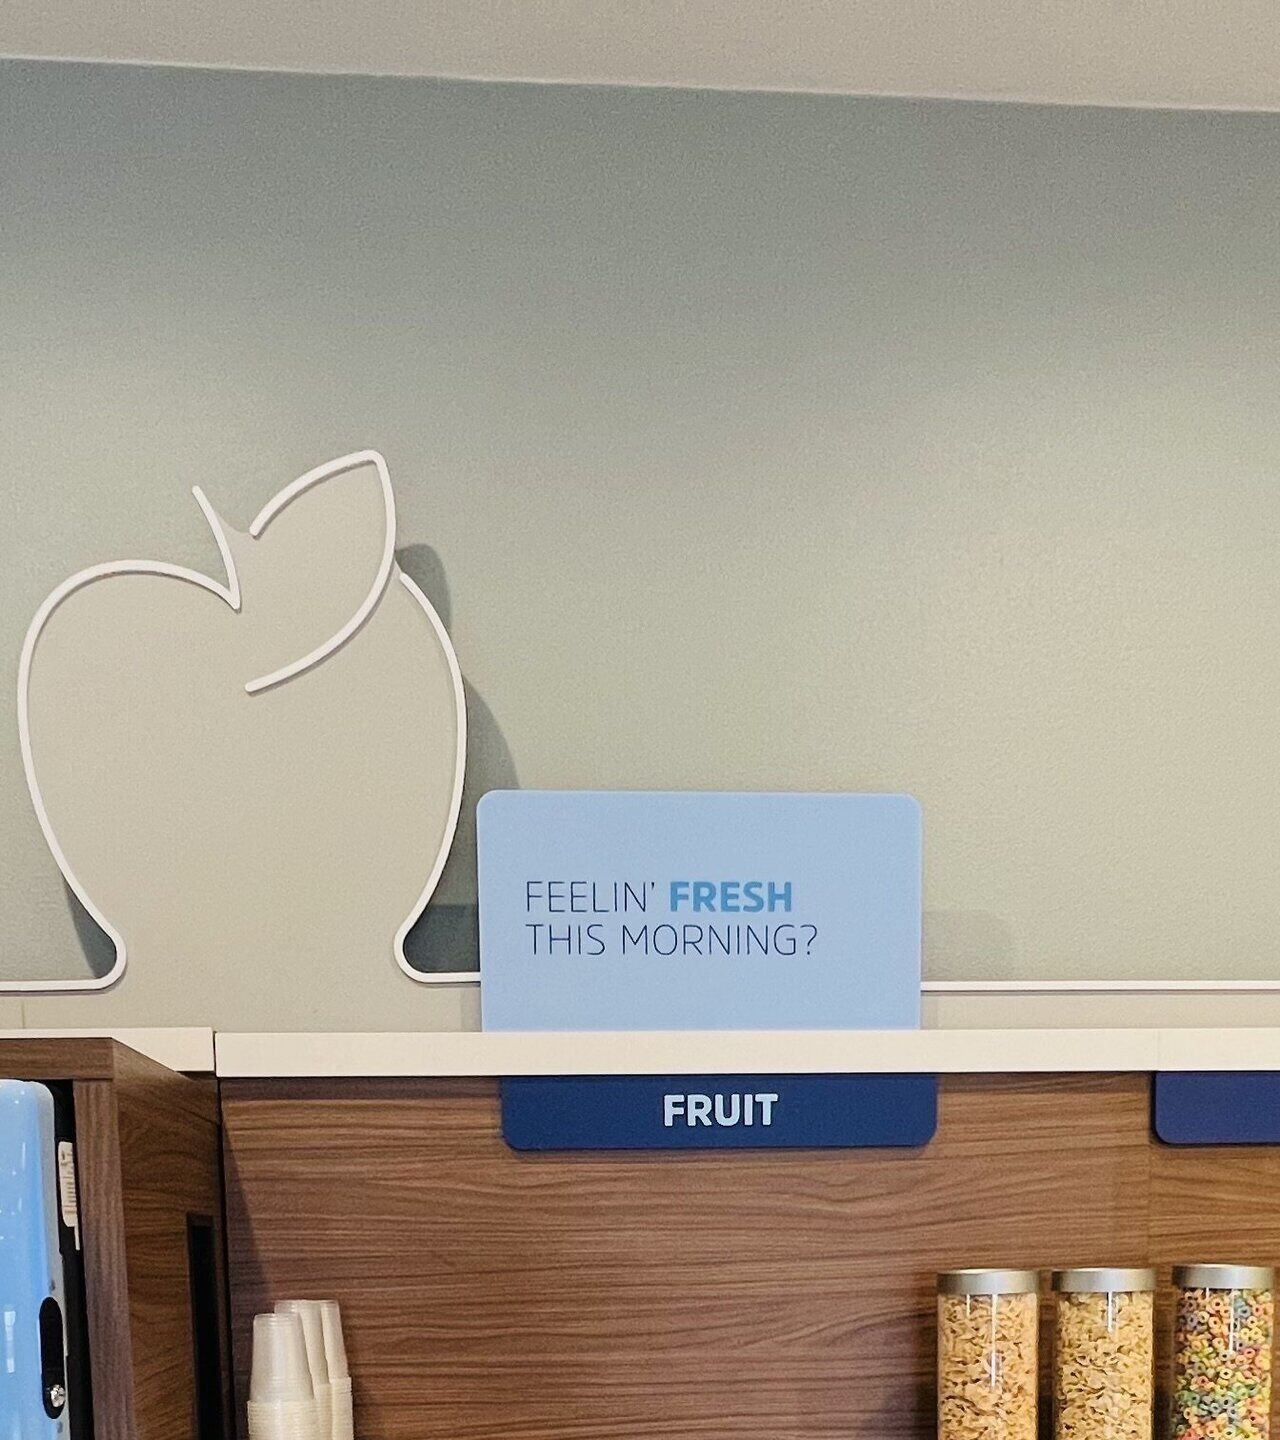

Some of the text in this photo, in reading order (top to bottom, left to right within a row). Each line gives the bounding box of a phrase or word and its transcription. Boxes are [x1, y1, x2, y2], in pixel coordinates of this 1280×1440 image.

[669, 880, 793, 913] FRESH
[525, 923, 819, 956] THIS MORNING?
[663, 1093, 780, 1127] FRUIT
